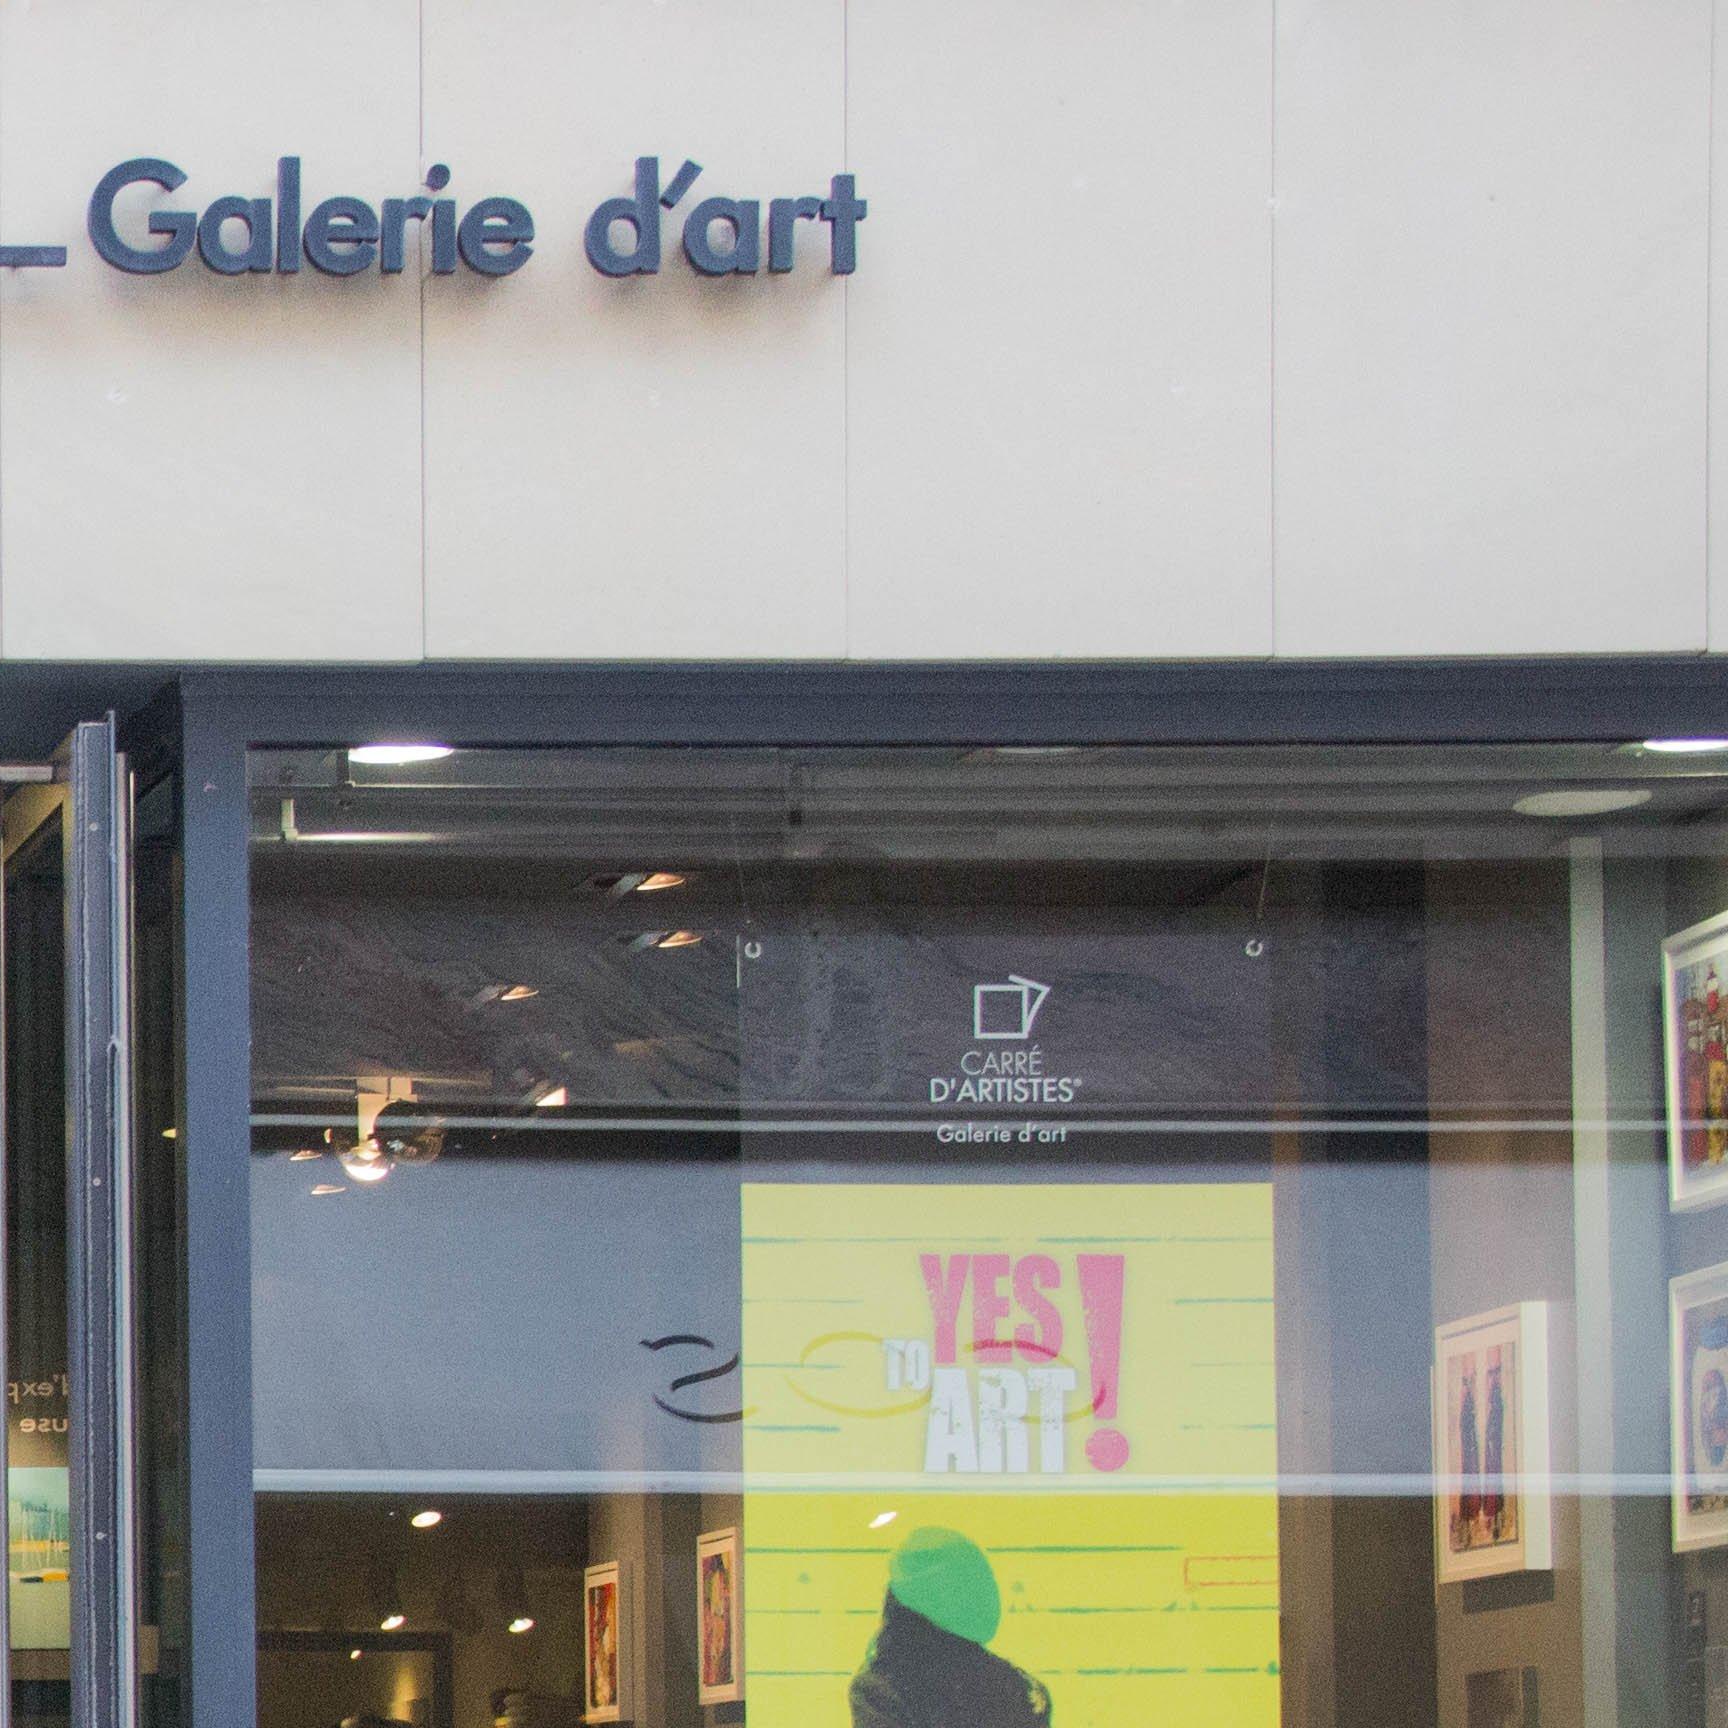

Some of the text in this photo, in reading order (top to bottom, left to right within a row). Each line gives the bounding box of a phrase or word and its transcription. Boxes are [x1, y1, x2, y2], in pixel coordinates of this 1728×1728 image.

[87, 155, 868, 278] Galerie d'art
[960, 1044, 1042, 1076] CARRÉ
[936, 1122, 1067, 1143] Galerie d'art
[919, 1254, 1063, 1364] YES
[882, 1339, 930, 1392] TO
[923, 1368, 1078, 1473] ART
